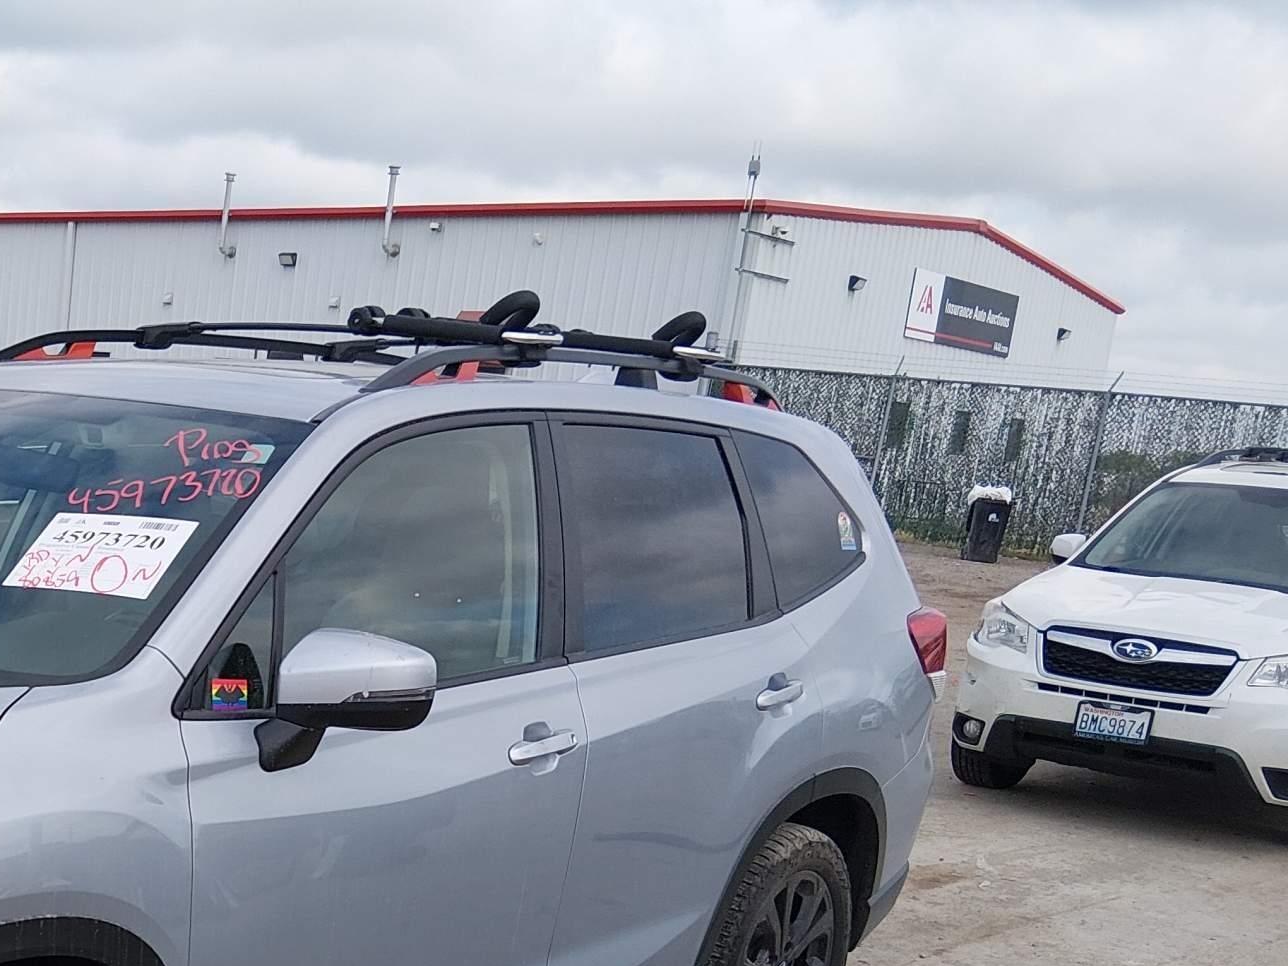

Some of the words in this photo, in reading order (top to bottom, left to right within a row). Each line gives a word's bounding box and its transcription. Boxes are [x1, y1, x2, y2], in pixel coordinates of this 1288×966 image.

[945, 298, 973, 319] Insurance
[973, 305, 987, 322] Auto
[986, 309, 1010, 328] Auctions
[52, 529, 166, 551] 45973720
[1079, 712, 1145, 738] BMC9874
